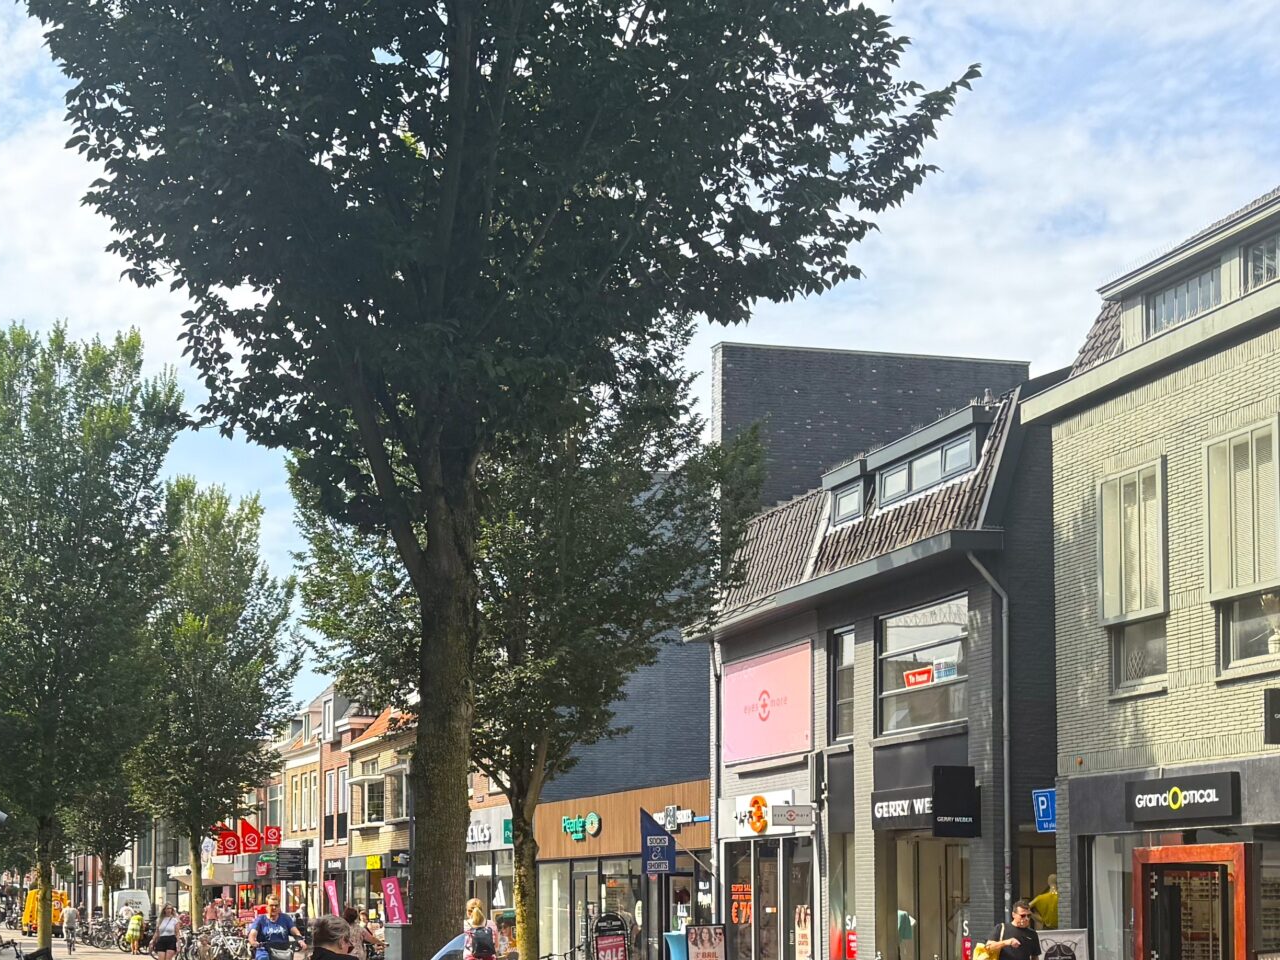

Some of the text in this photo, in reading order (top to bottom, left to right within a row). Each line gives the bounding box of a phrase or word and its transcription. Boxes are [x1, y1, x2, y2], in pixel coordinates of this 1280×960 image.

[874, 799, 911, 819] GERRY
[1038, 796, 1047, 817] P
[954, 816, 973, 824] WEBER
[648, 837, 668, 846] SOCKS
[647, 862, 668, 871] SHORTS
[701, 951, 719, 959] BRIL
